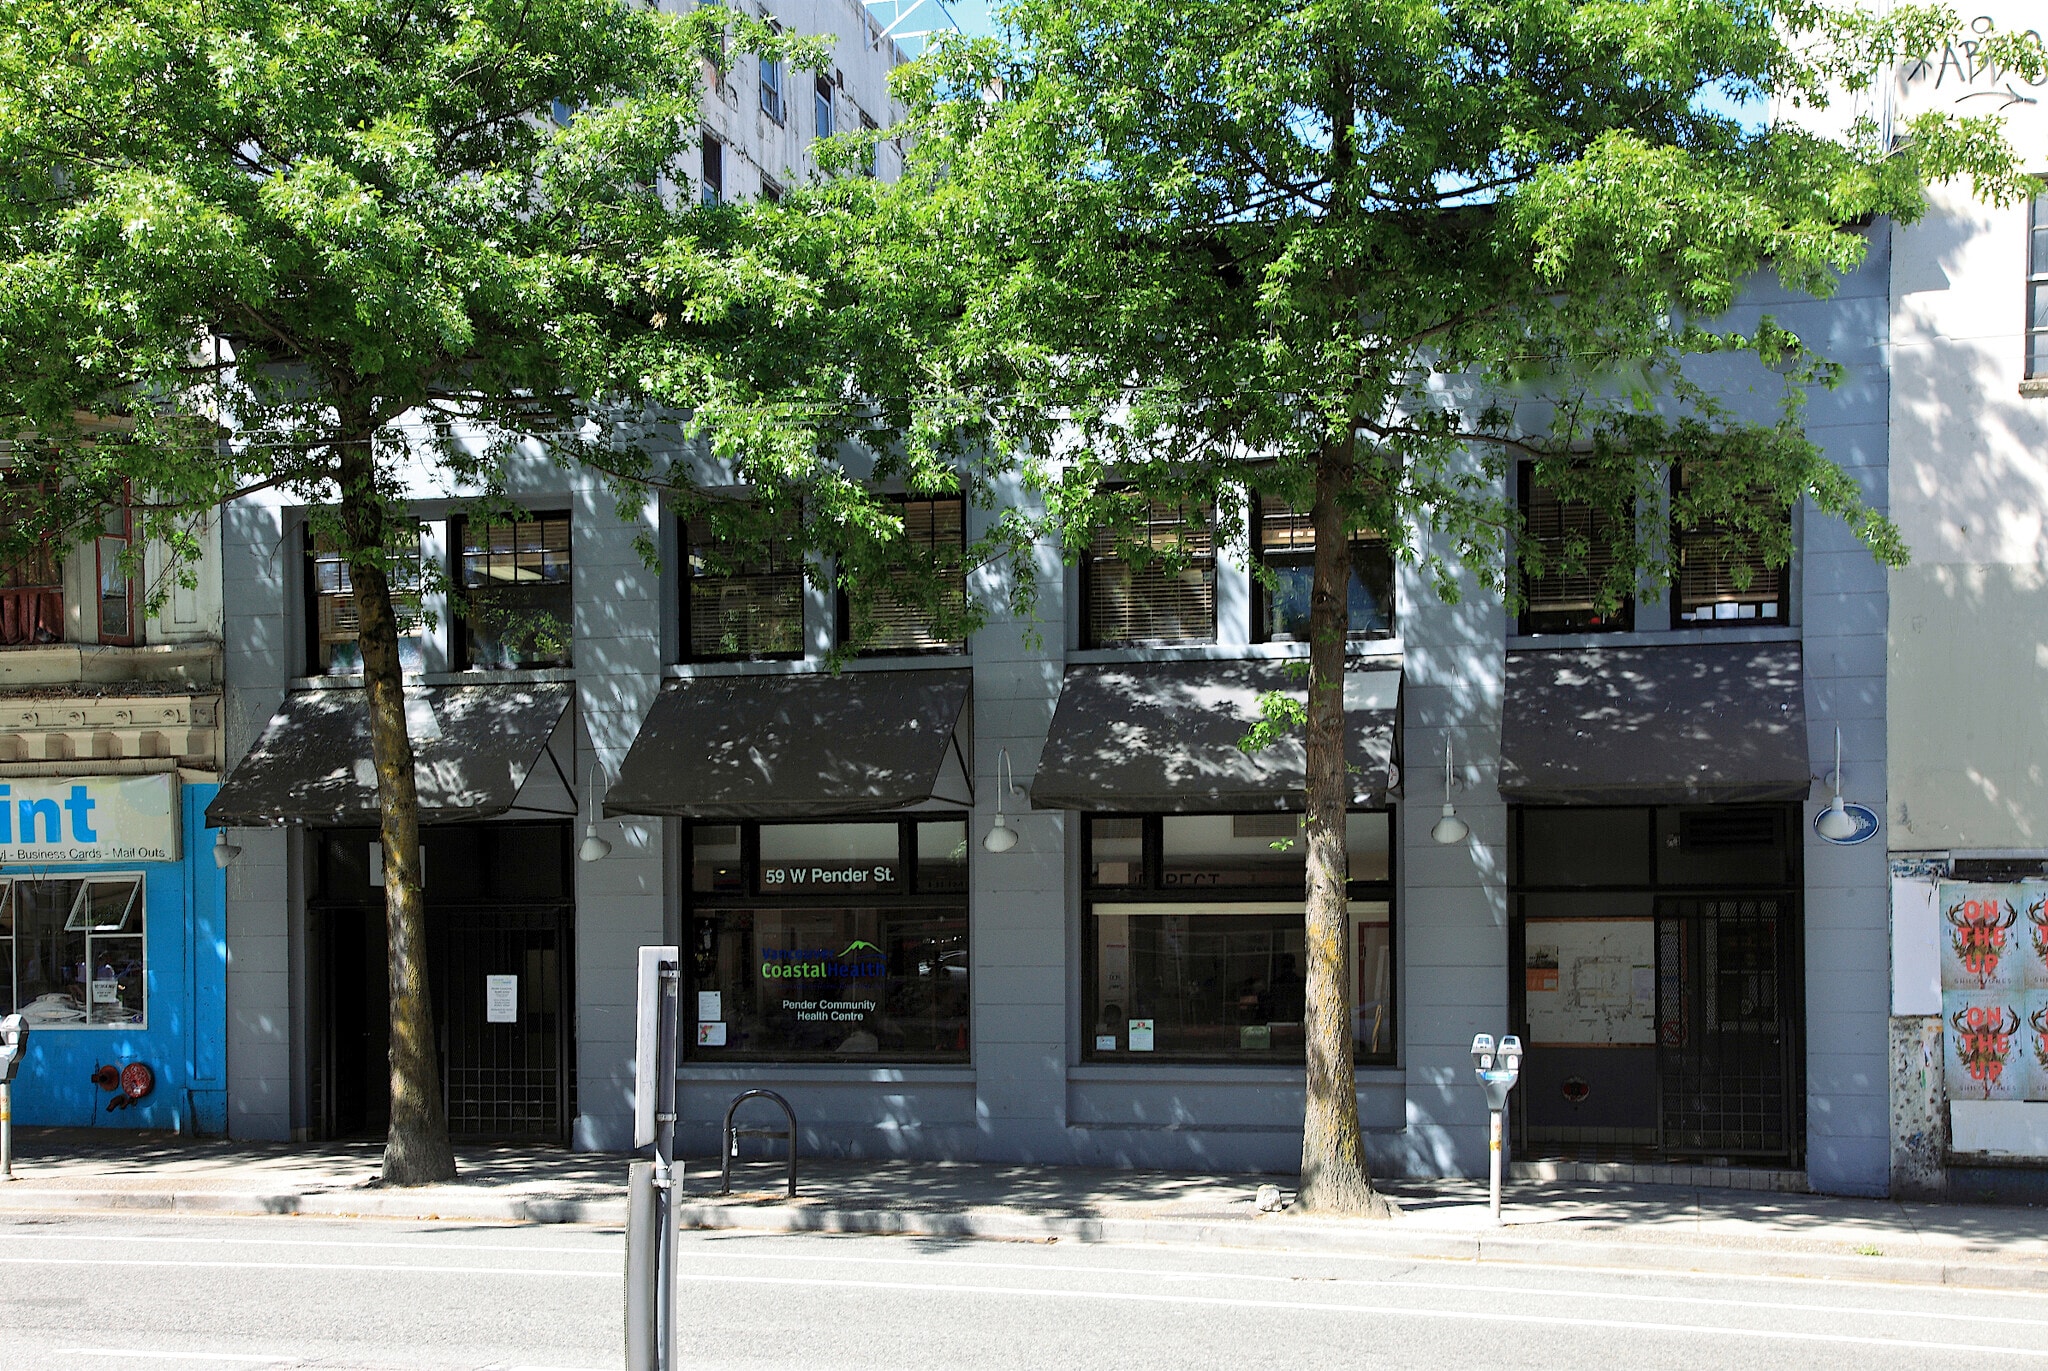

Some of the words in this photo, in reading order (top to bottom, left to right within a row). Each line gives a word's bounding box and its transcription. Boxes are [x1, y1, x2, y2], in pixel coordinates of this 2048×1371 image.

[0, 784, 97, 844] int
[17, 849, 66, 860] Business
[69, 848, 102, 860] Cards
[112, 847, 135, 858] Mail
[138, 847, 166, 858] Outs
[765, 869, 786, 884] 59
[789, 868, 807, 884] W
[811, 867, 869, 883] Pender
[873, 866, 895, 882] St.
[1964, 900, 1998, 919] ON
[1958, 926, 2005, 947] THE
[762, 948, 835, 960] Vancouver
[762, 962, 887, 978] CoastalHealth
[1966, 953, 1999, 975] UP
[782, 1000, 817, 1010] Pender
[819, 1000, 876, 1012] Community
[797, 1011, 828, 1021] Health
[831, 1011, 864, 1021] Centre
[1967, 1006, 2000, 1027] ON
[1961, 1033, 2009, 1053] THE
[1970, 1061, 2003, 1082] UP
